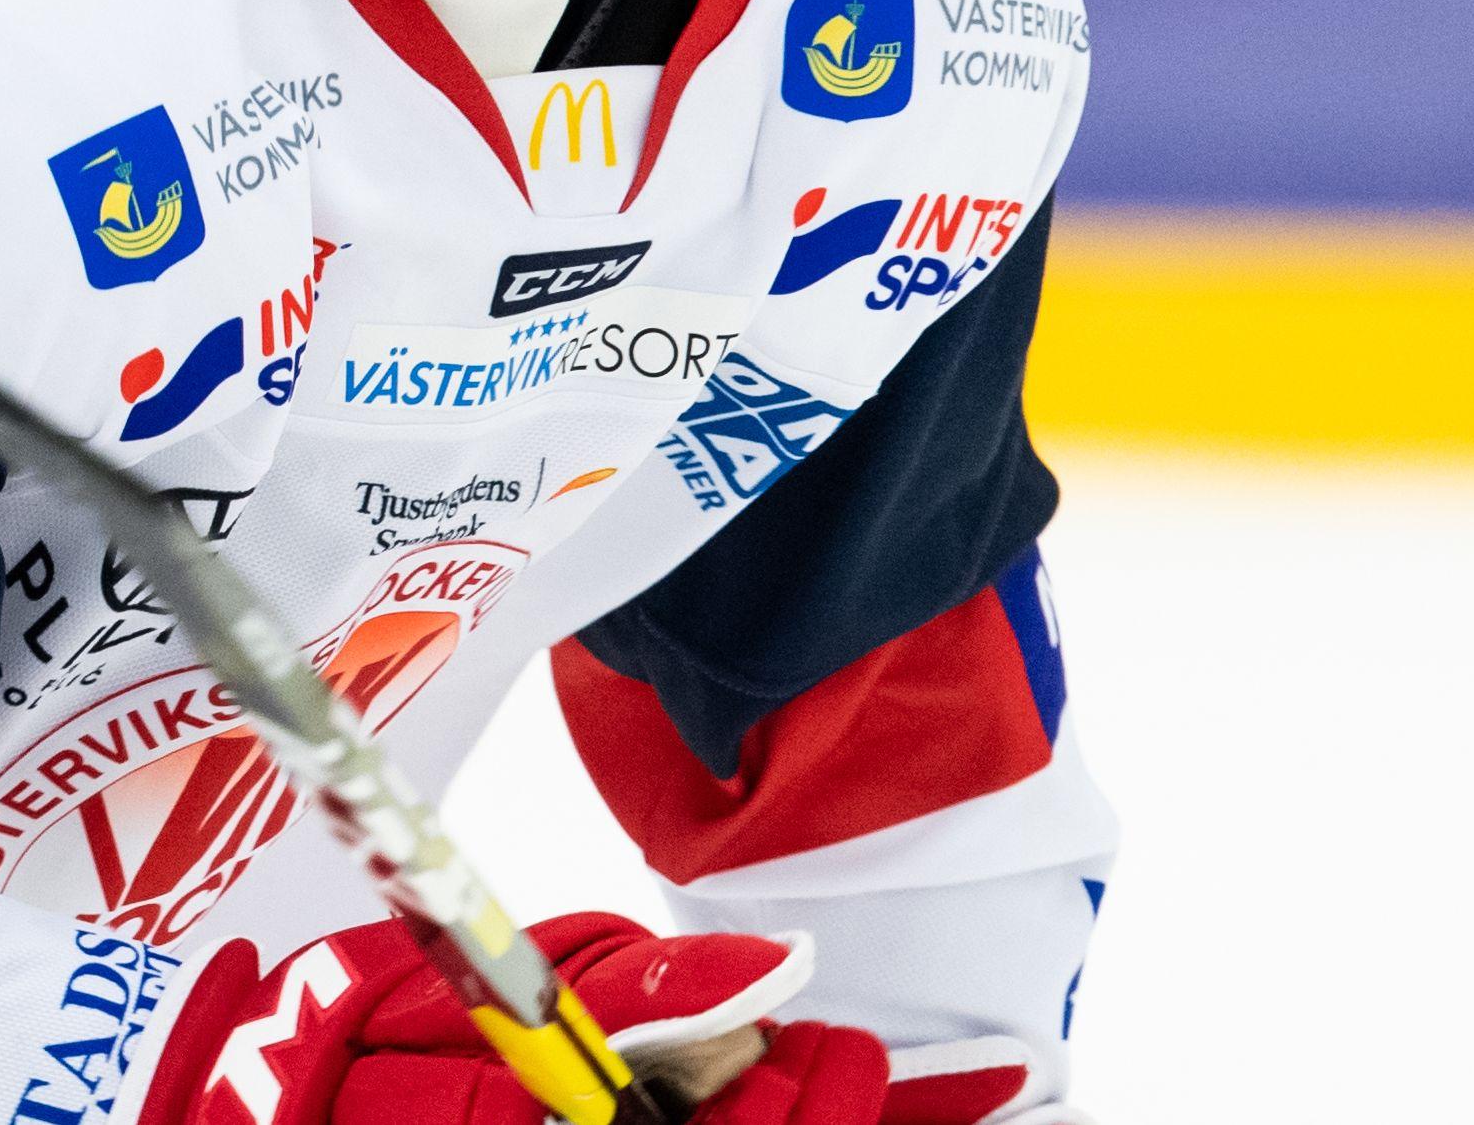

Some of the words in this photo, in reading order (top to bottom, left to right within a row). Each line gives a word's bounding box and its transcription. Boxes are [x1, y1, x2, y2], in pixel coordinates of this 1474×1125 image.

[941, 50, 1054, 94] KOMMUN
[502, 254, 643, 303] CCM
[655, 433, 727, 512] TNER
[9, 929, 139, 1125] TADS
